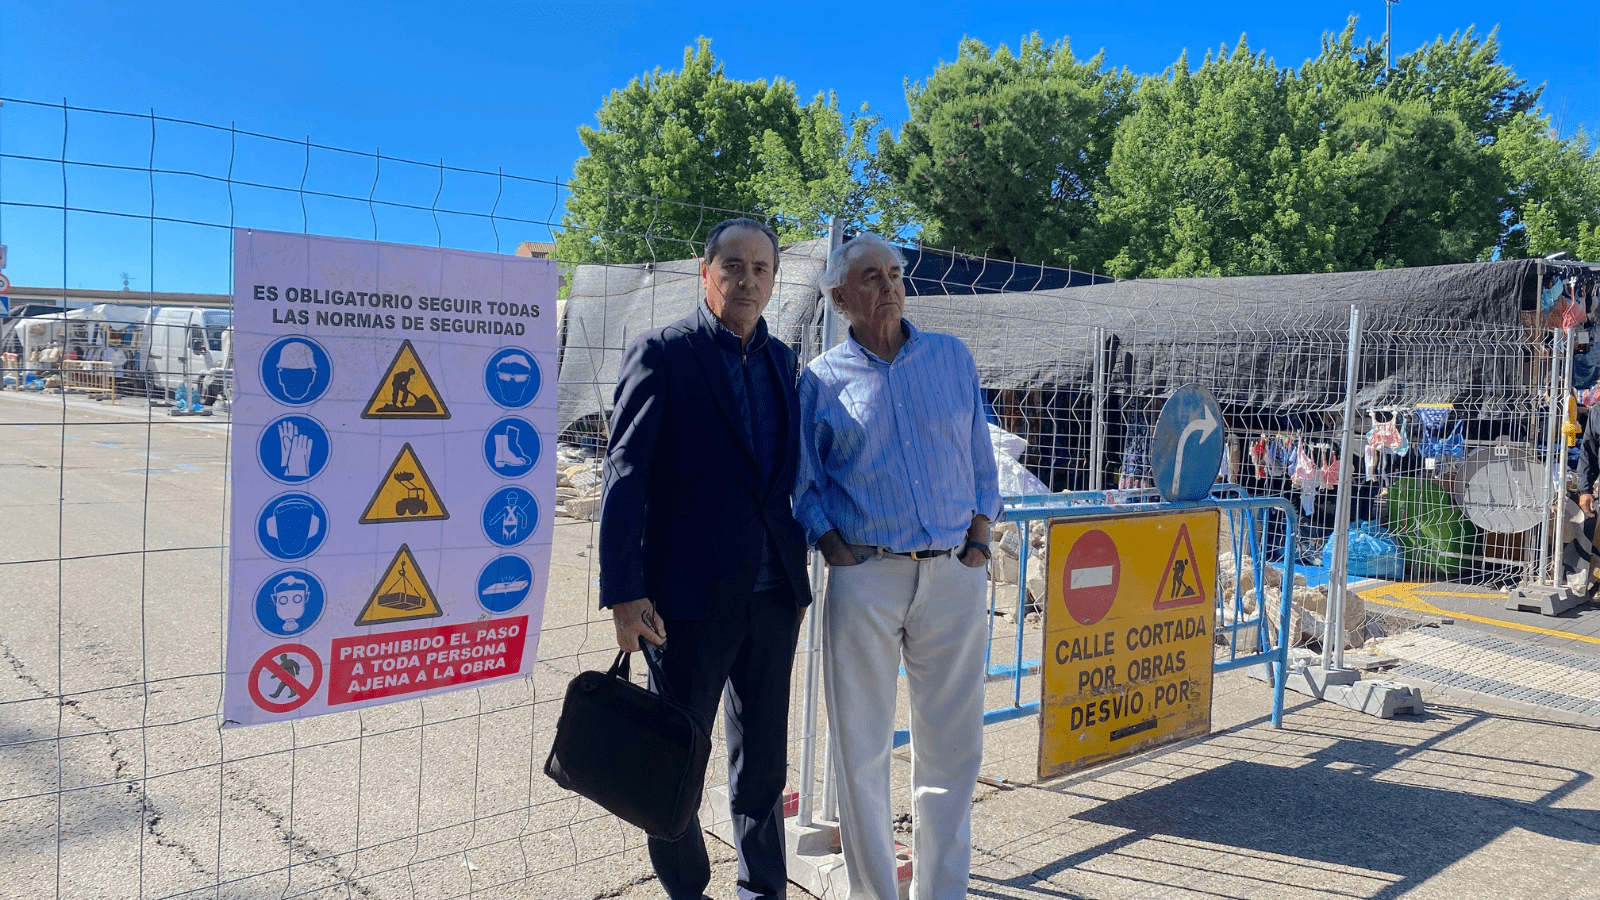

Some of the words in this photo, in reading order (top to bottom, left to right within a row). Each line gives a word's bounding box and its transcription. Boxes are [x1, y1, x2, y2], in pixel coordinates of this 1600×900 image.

[253, 285, 278, 301] ES
[285, 287, 413, 310] OBLIGATORIO
[418, 296, 482, 315] SEGUIR
[487, 301, 540, 318] TODAS
[272, 308, 310, 325] LAS
[316, 311, 396, 329] NORMAS
[402, 316, 424, 331] DE
[429, 317, 526, 336] SEGURIDAD
[340, 635, 445, 660] PROHIBIDO
[450, 632, 470, 644] EL
[475, 625, 520, 641] PASO
[1055, 631, 1115, 665] CALLE
[1126, 615, 1207, 651] CORTADA
[347, 675, 411, 693] AJENA
[414, 670, 427, 682] A
[432, 667, 455, 679] LA
[460, 657, 506, 675] OBRA
[351, 663, 364, 676] A
[370, 655, 420, 673] TODA
[426, 642, 507, 665] PERSONA
[1078, 664, 1116, 695] POR
[1127, 650, 1186, 683] OBRAS
[1154, 680, 1190, 709] POR
